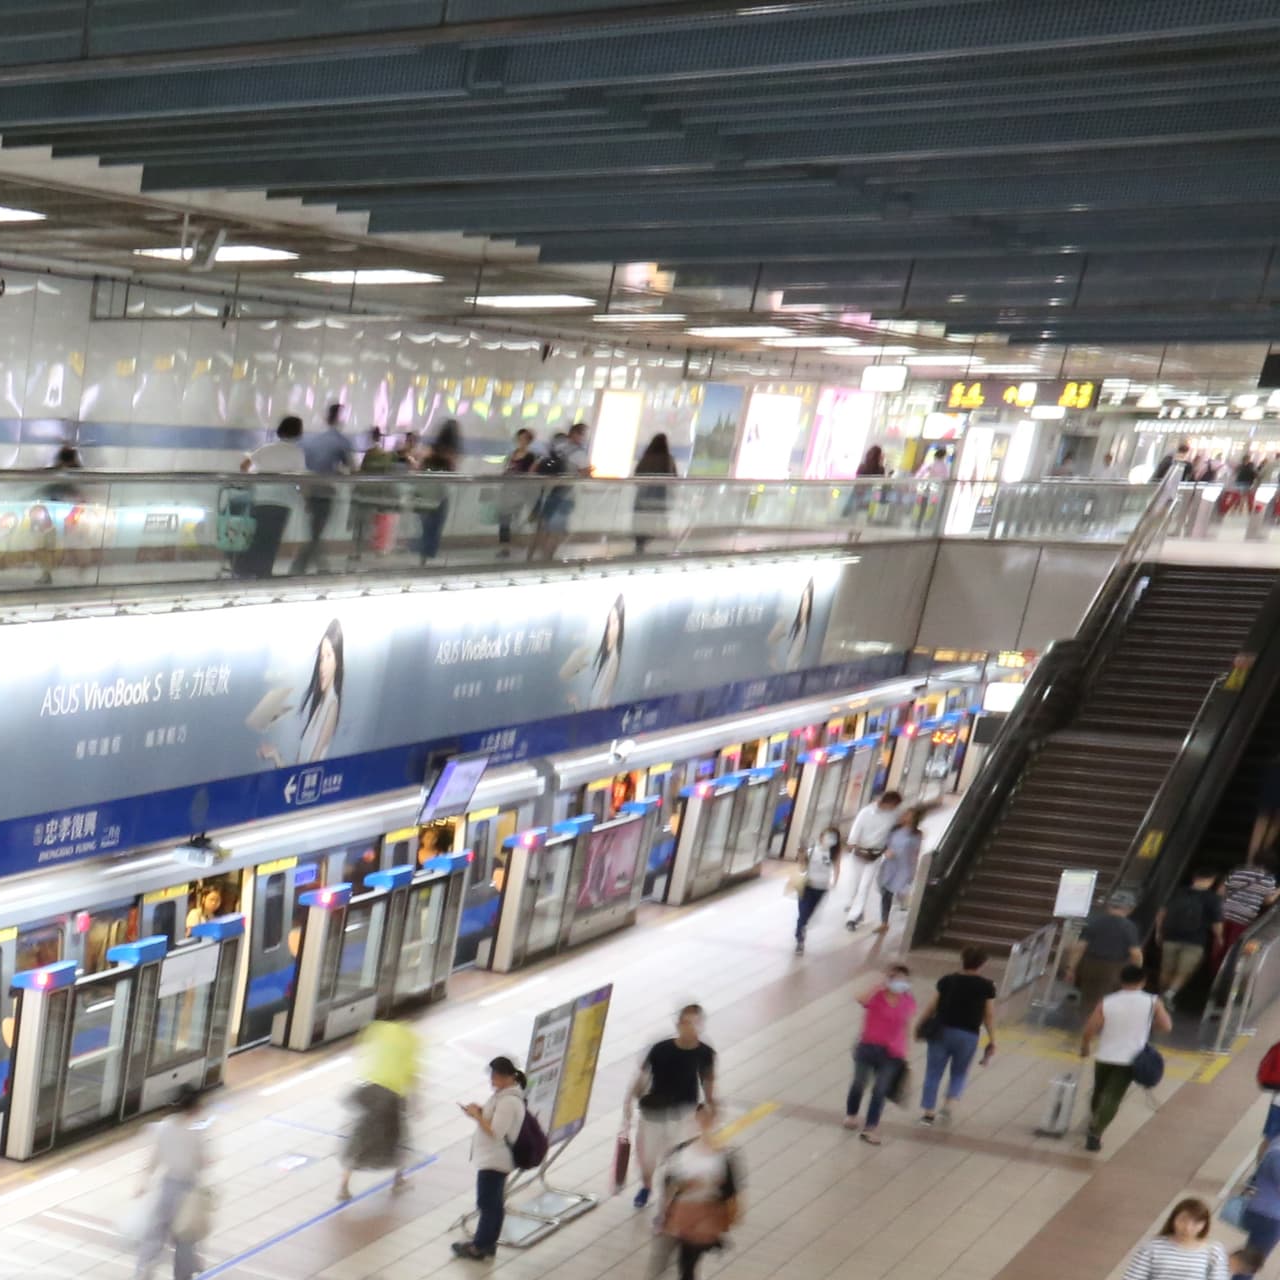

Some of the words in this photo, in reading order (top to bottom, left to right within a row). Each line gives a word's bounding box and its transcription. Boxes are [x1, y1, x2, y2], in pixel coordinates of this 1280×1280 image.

[40, 682, 80, 718] ASUS
[83, 675, 152, 712] VivoBook
[152, 672, 163, 702] S
